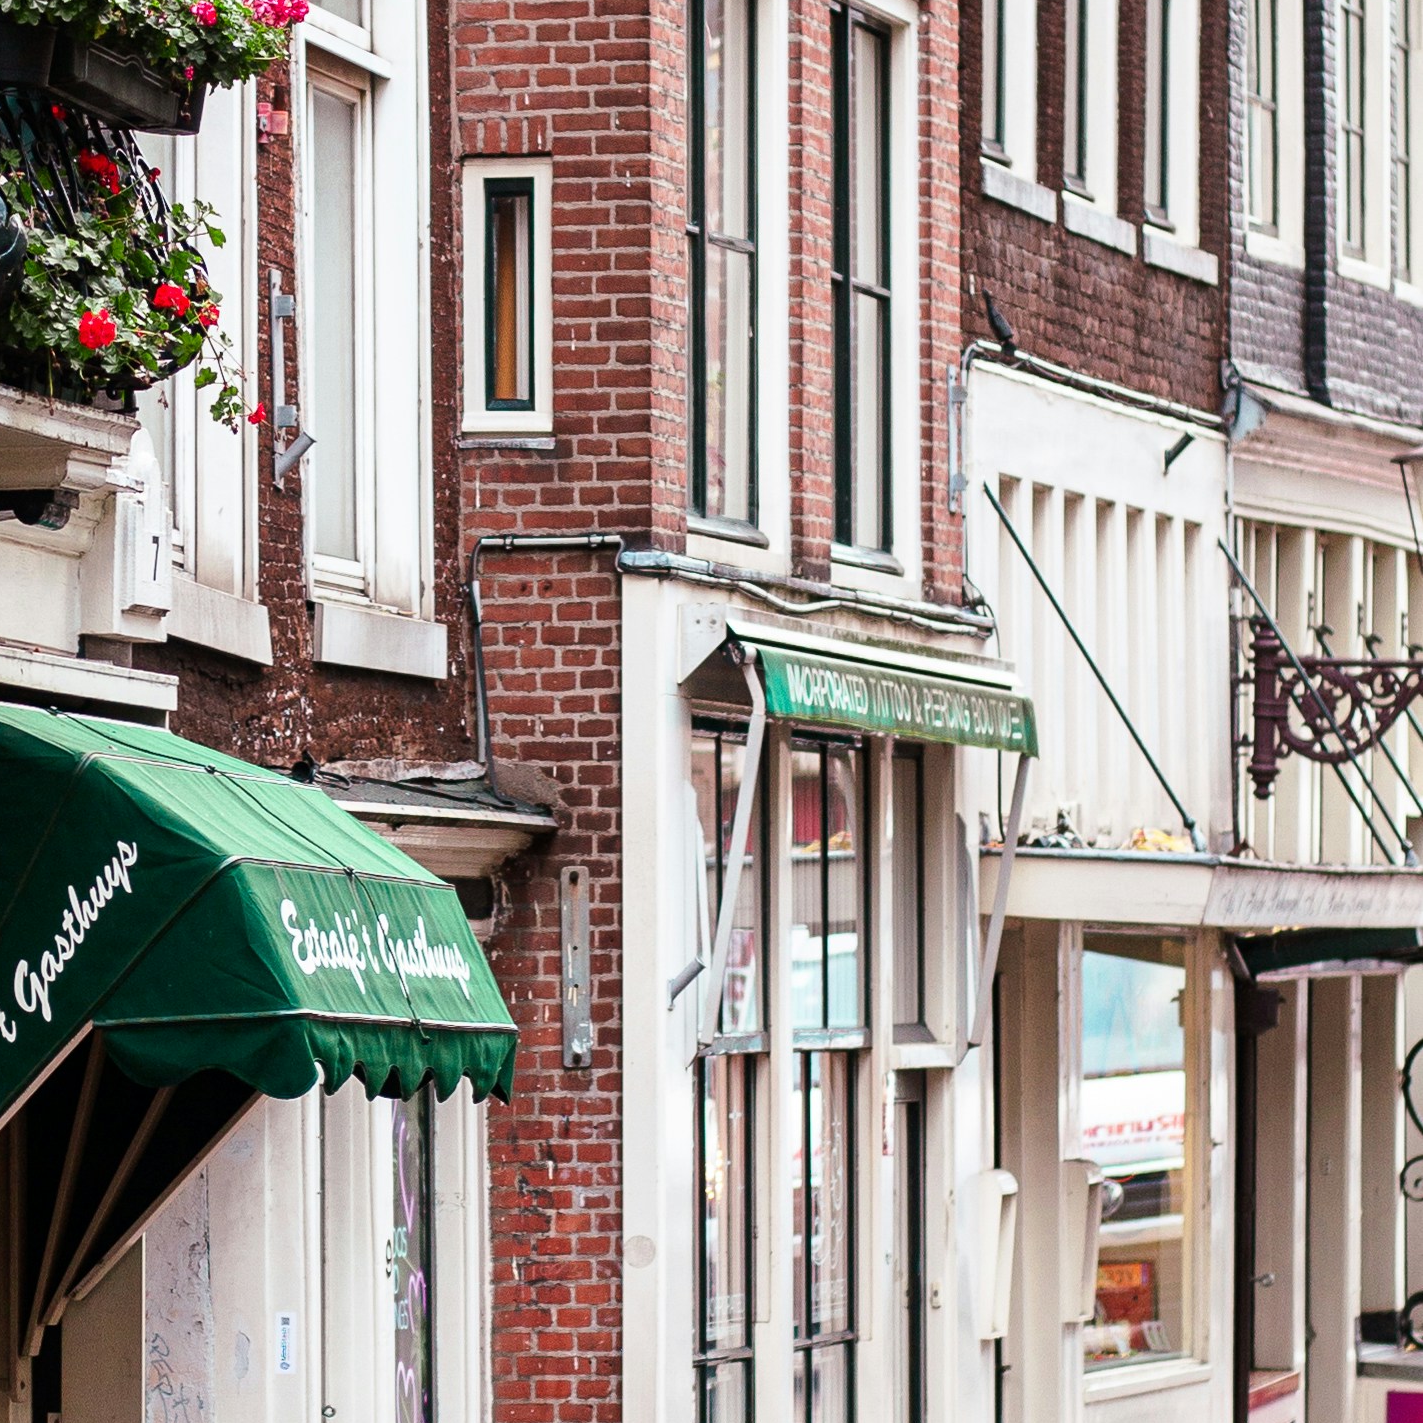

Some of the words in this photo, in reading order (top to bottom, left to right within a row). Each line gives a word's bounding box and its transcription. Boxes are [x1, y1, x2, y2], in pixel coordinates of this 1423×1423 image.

[868, 678, 912, 722] TATTOO
[923, 687, 971, 732] PIERCING
[970, 696, 1023, 740] BOUTIQUE
[13, 840, 139, 1022] Gasthuys
[376, 913, 471, 1001] Gasthuys
